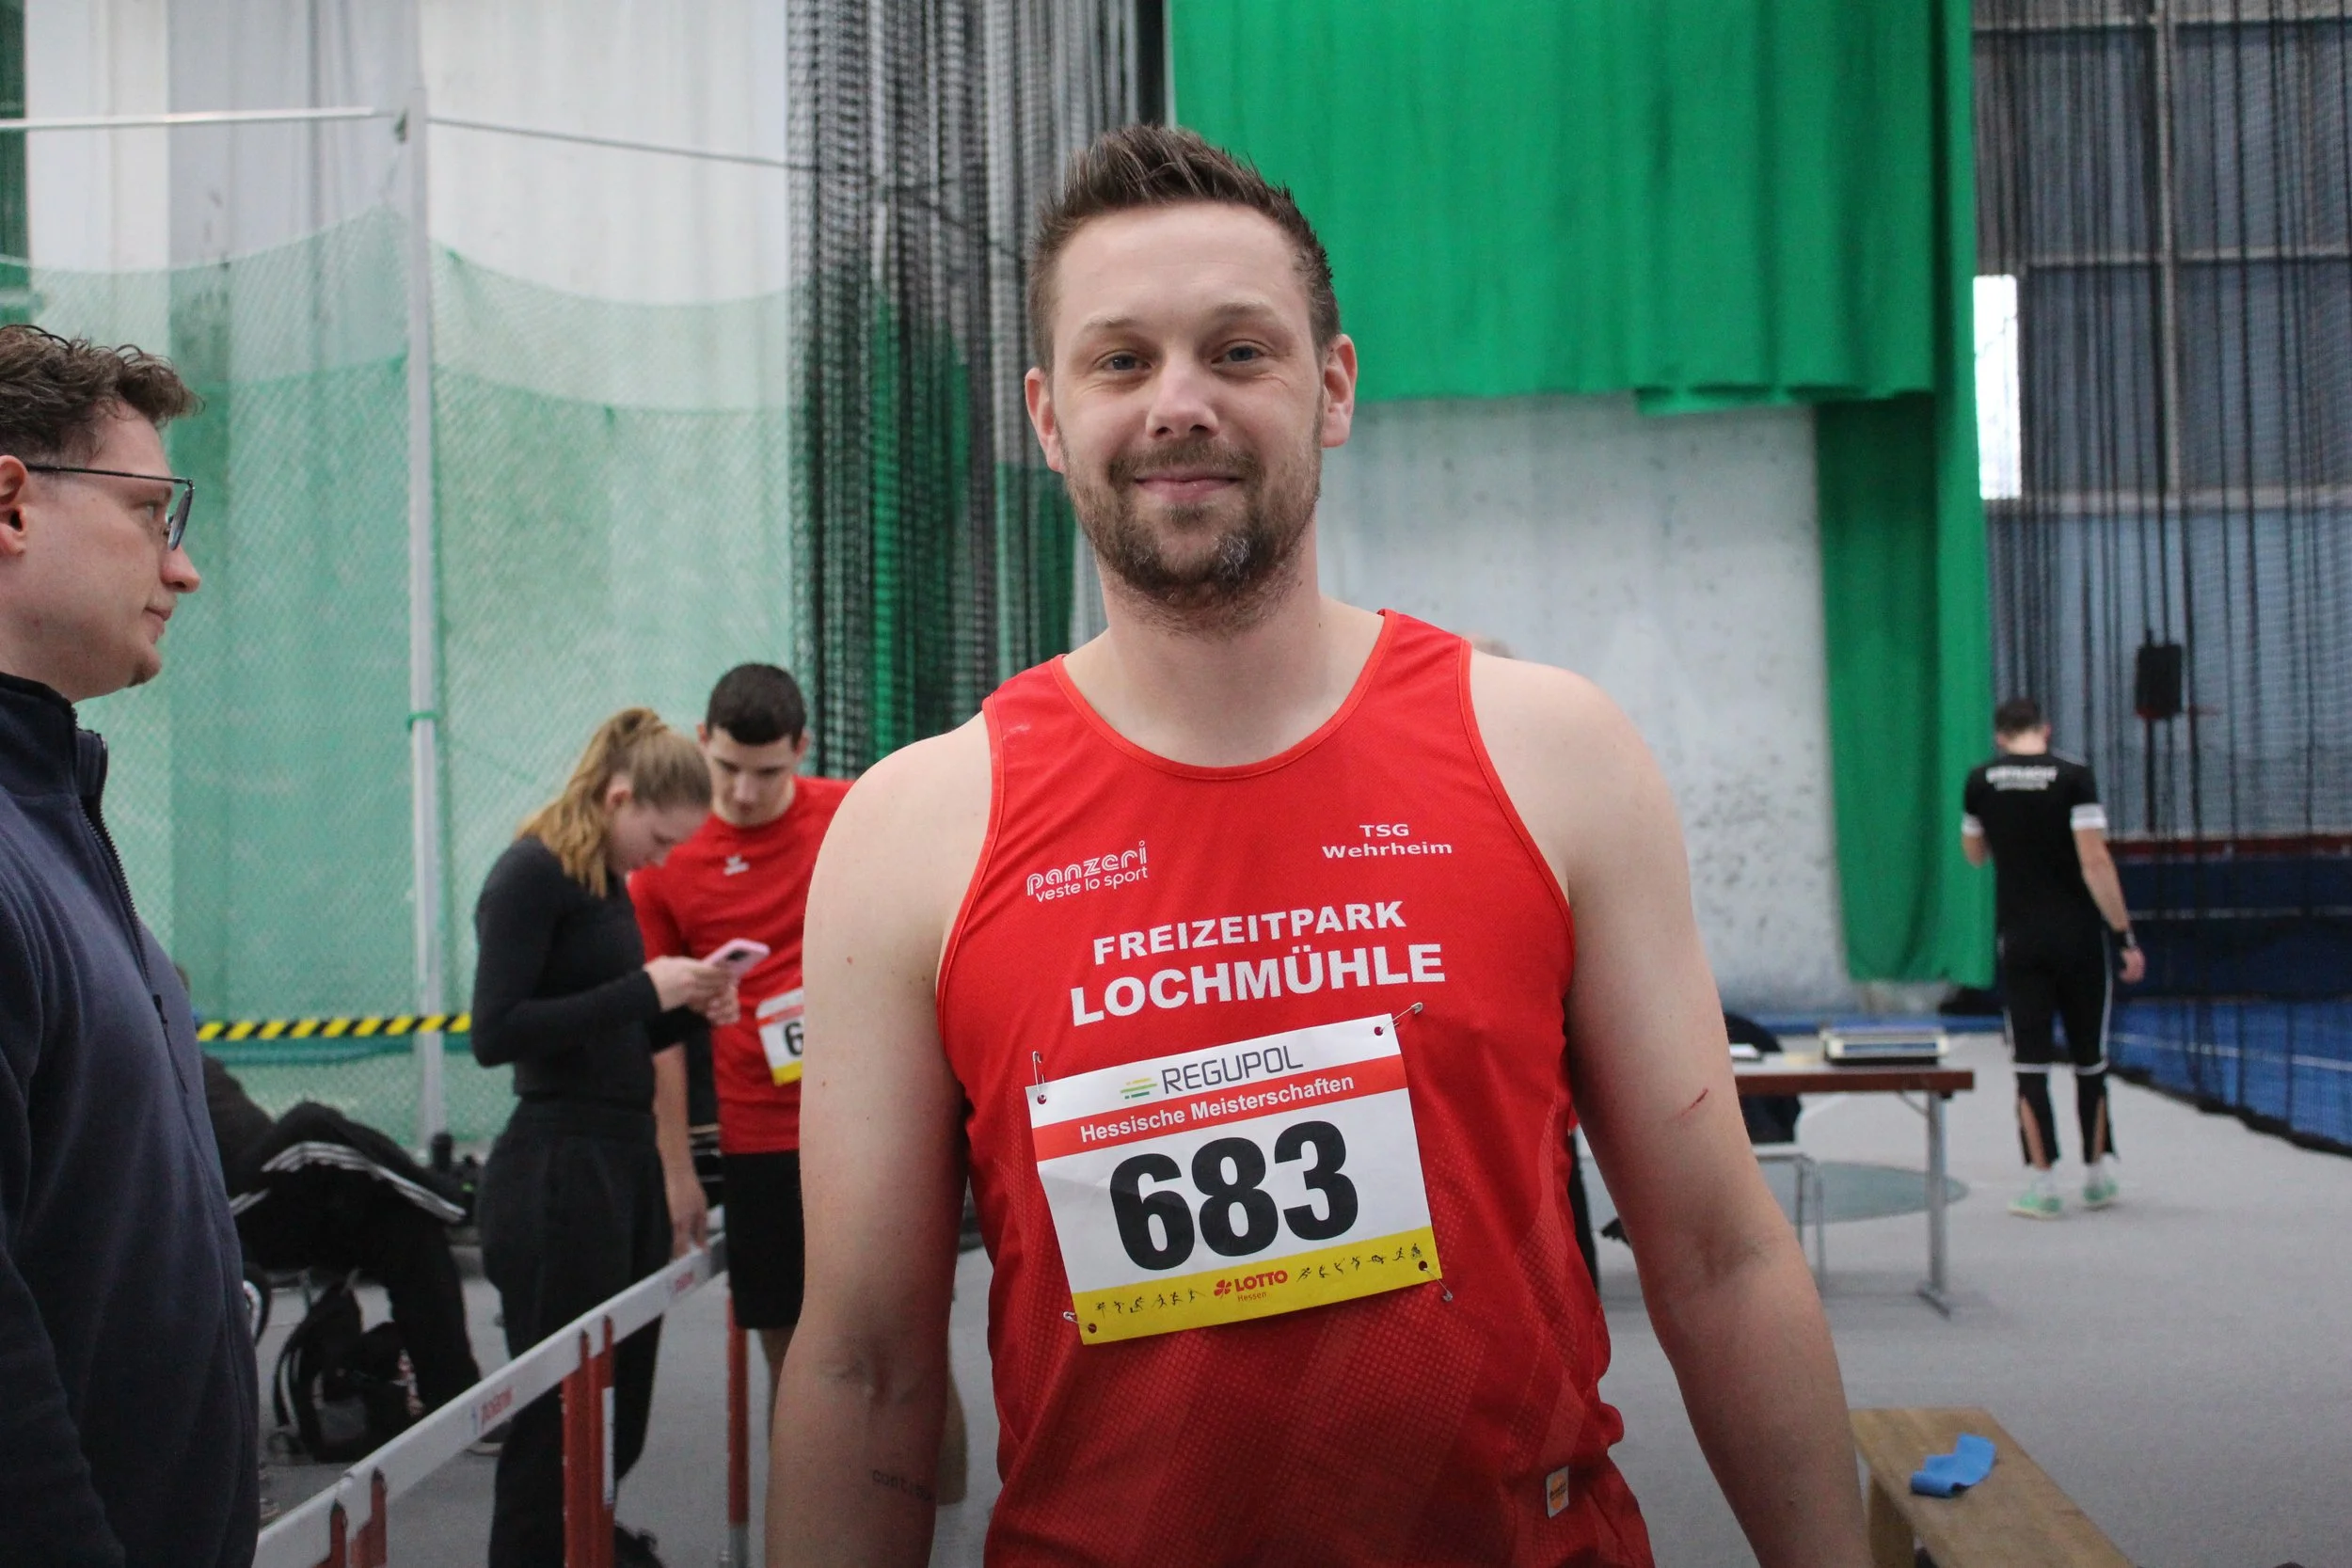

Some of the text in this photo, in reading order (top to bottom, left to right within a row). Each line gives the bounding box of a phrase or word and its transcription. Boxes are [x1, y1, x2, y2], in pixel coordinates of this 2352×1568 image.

[1322, 841, 1453, 860] Wehrheim
[1359, 823, 1410, 838] TSG
[1026, 840, 1148, 896] panzeri
[1036, 866, 1148, 903] veste lo sport
[1093, 900, 1406, 965] FREIZEITPARK
[1070, 943, 1445, 1027] LOCHMÜHLE
[1161, 1045, 1304, 1094] REGUPOL
[1080, 1075, 1355, 1143] Hessische Meisterschaften
[1109, 1120, 1359, 1271] 683
[1234, 1270, 1288, 1292] LOTTO
[1237, 1291, 1267, 1303] Hessen
